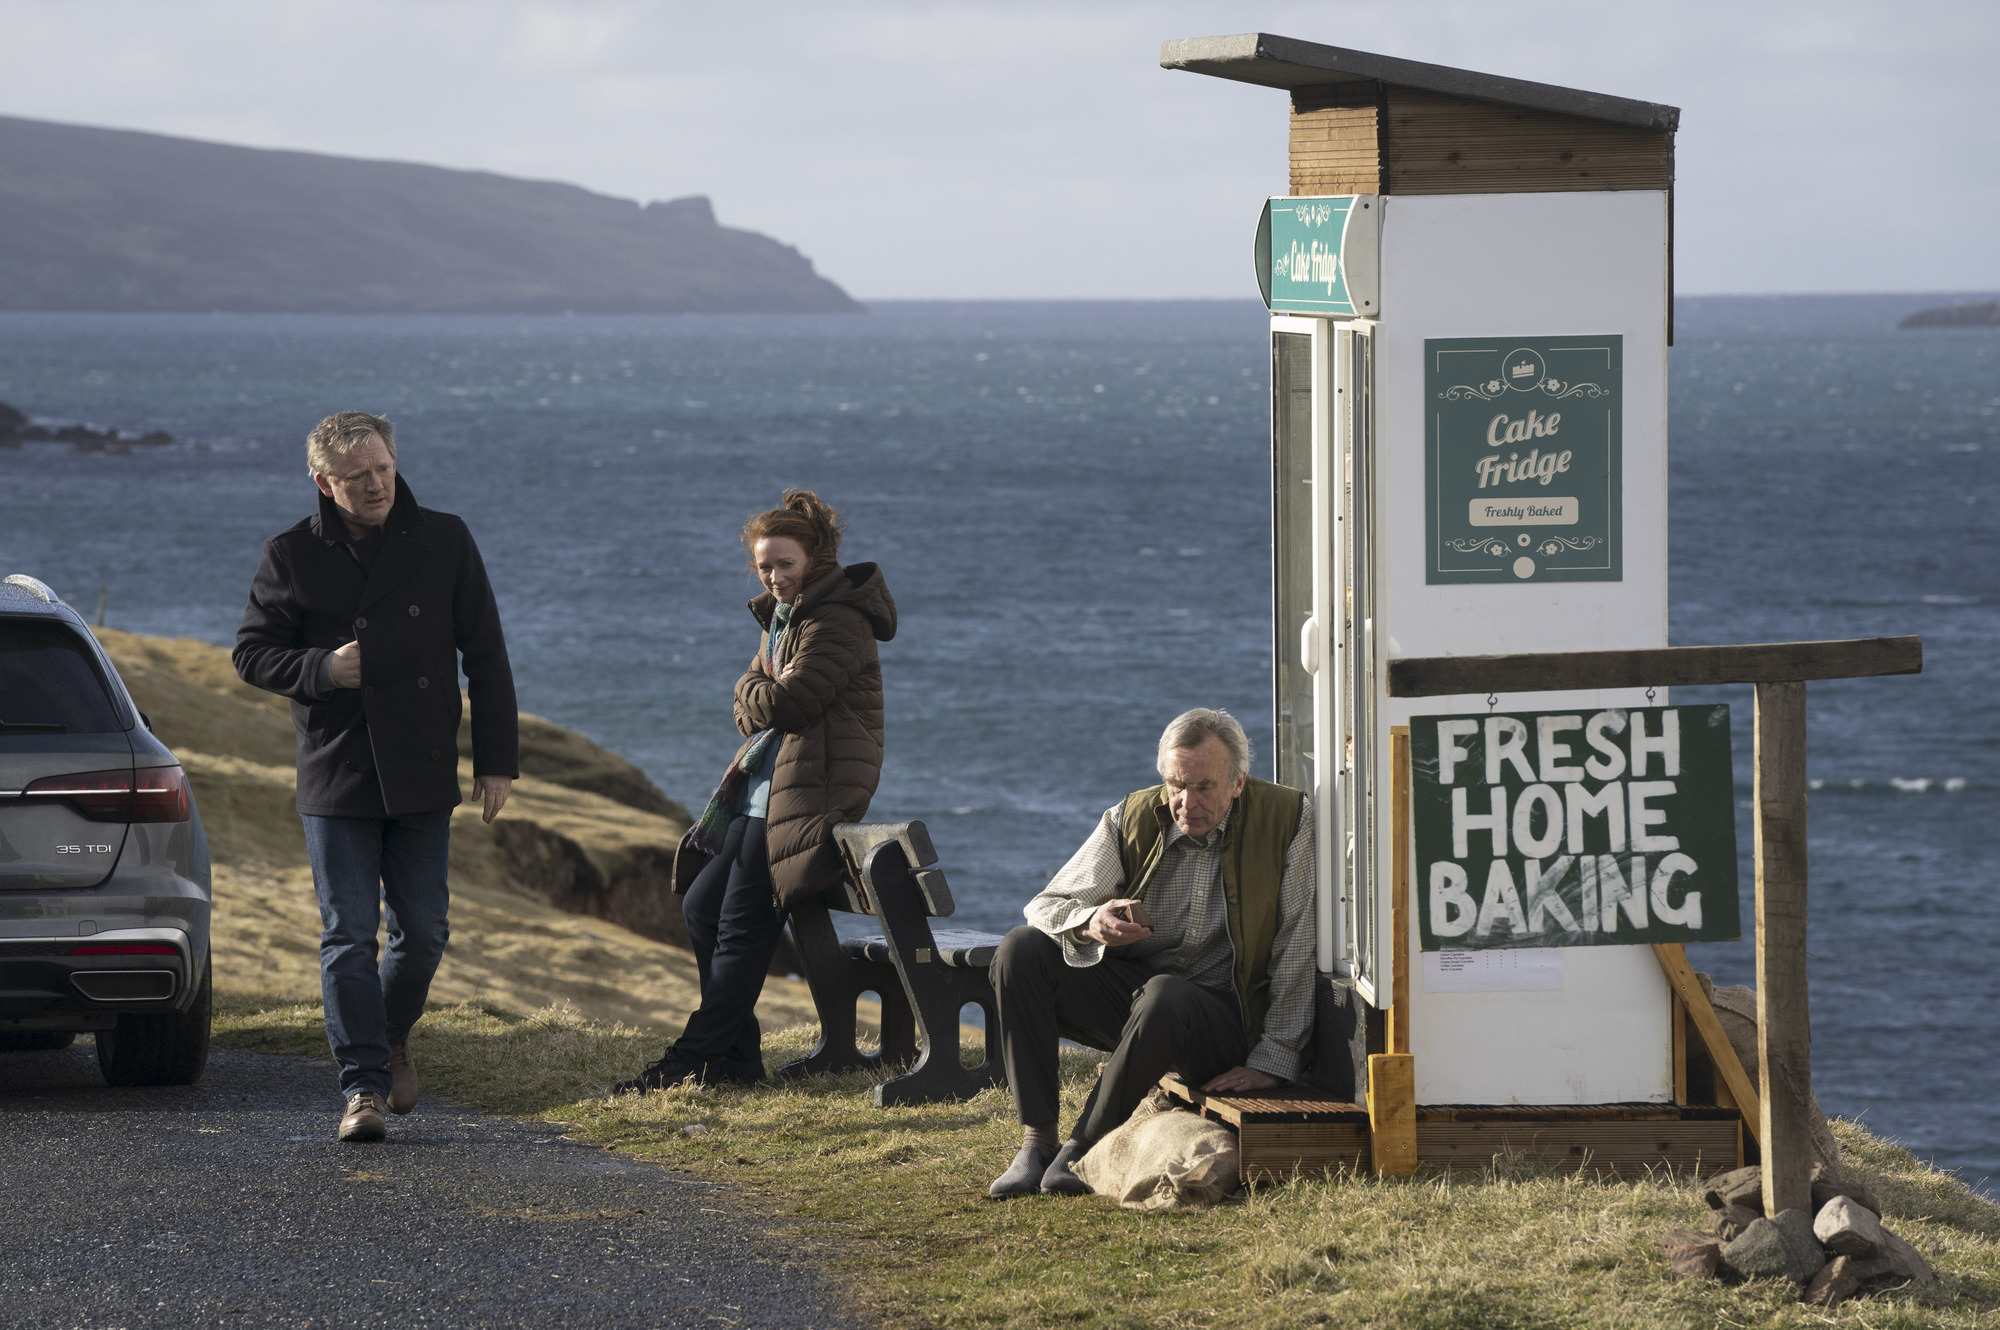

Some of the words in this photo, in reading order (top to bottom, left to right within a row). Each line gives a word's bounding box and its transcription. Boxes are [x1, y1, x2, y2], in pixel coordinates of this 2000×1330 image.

[1291, 240, 1310, 283] Cake
[1311, 239, 1337, 296] Fridge
[1487, 409, 1562, 447] Cake
[1475, 448, 1572, 489] Fridge
[1484, 505, 1524, 520] Freshly
[1527, 505, 1562, 517] Baked
[1437, 709, 1681, 784] FRESH
[1451, 781, 1680, 859] HOME
[56, 845, 81, 854] 35
[85, 844, 112, 853] TDI
[1429, 852, 1703, 937] BAKING
